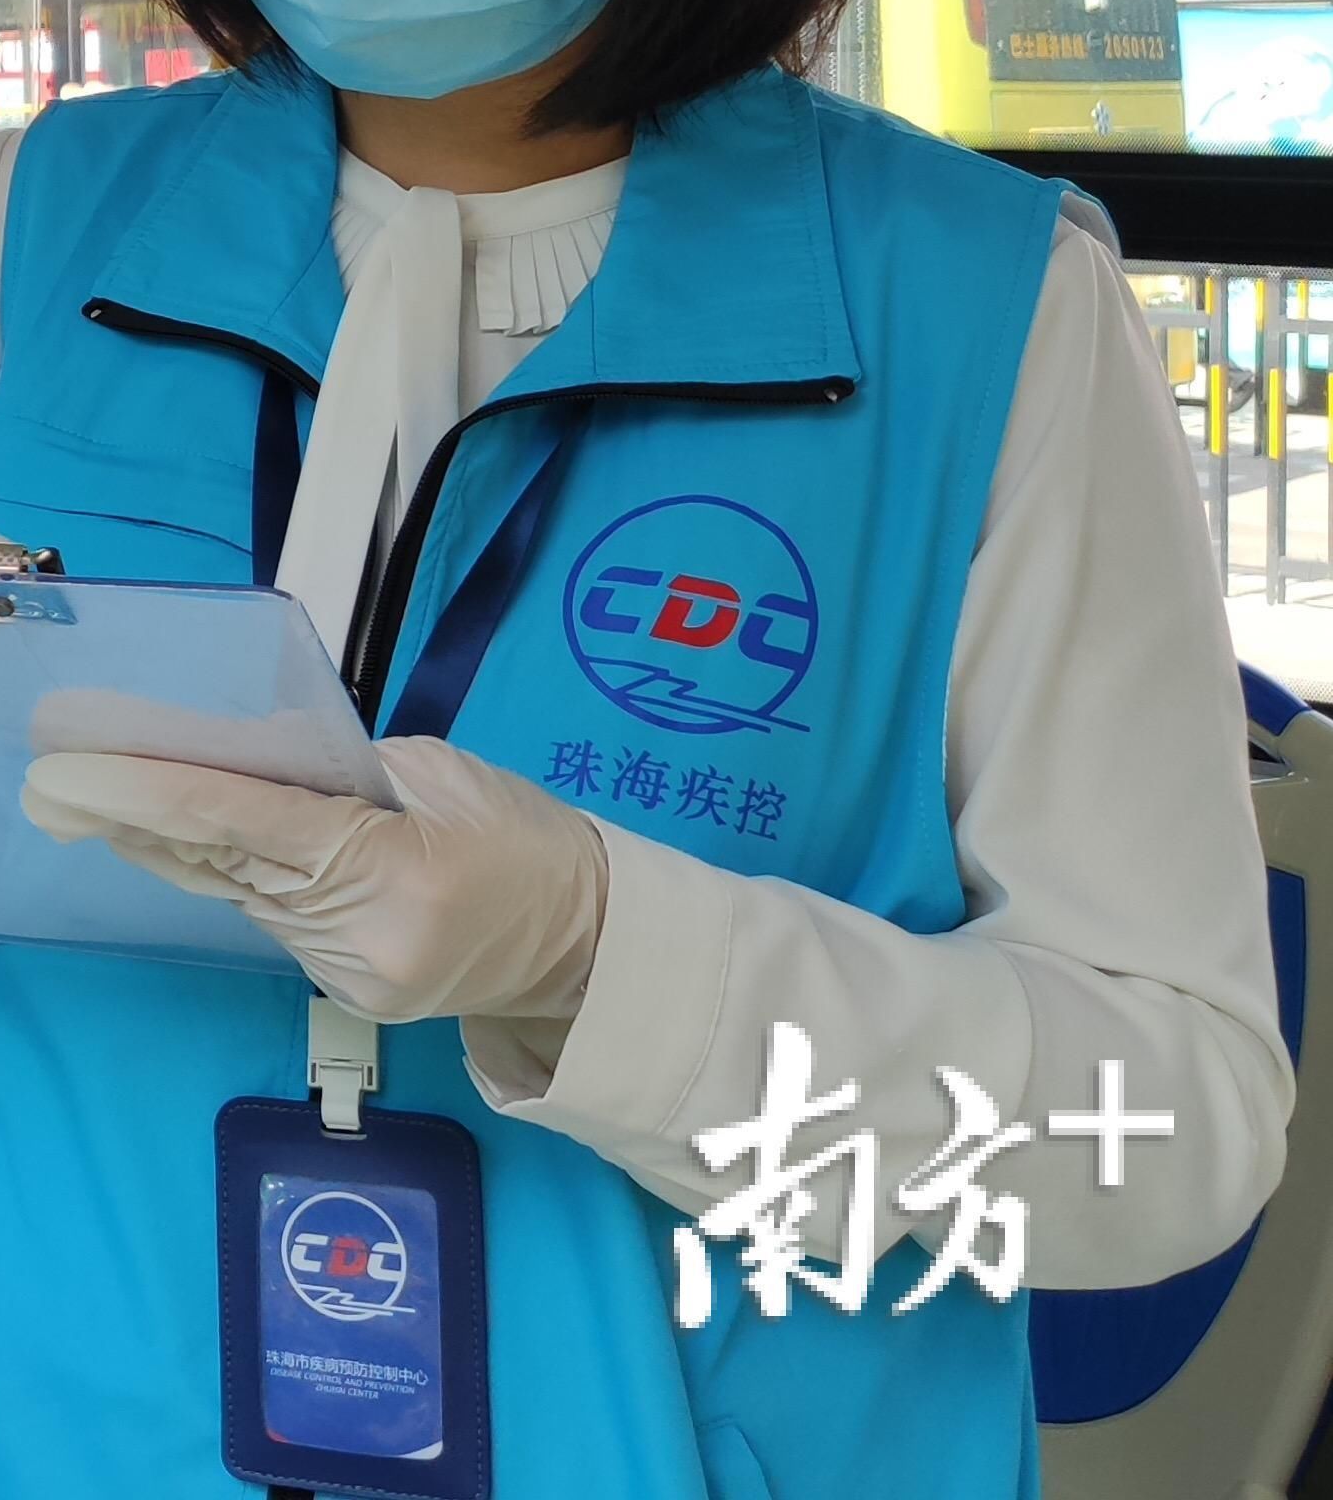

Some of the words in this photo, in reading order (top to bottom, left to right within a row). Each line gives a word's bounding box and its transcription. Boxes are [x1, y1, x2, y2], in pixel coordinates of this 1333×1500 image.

[579, 565, 810, 672] CDC
[543, 738, 787, 842] 珠海疾控
[289, 1232, 406, 1283] CDC
[266, 1350, 429, 1386] 珠海市疾病预防控制中心
[344, 1377, 363, 1388] AND
